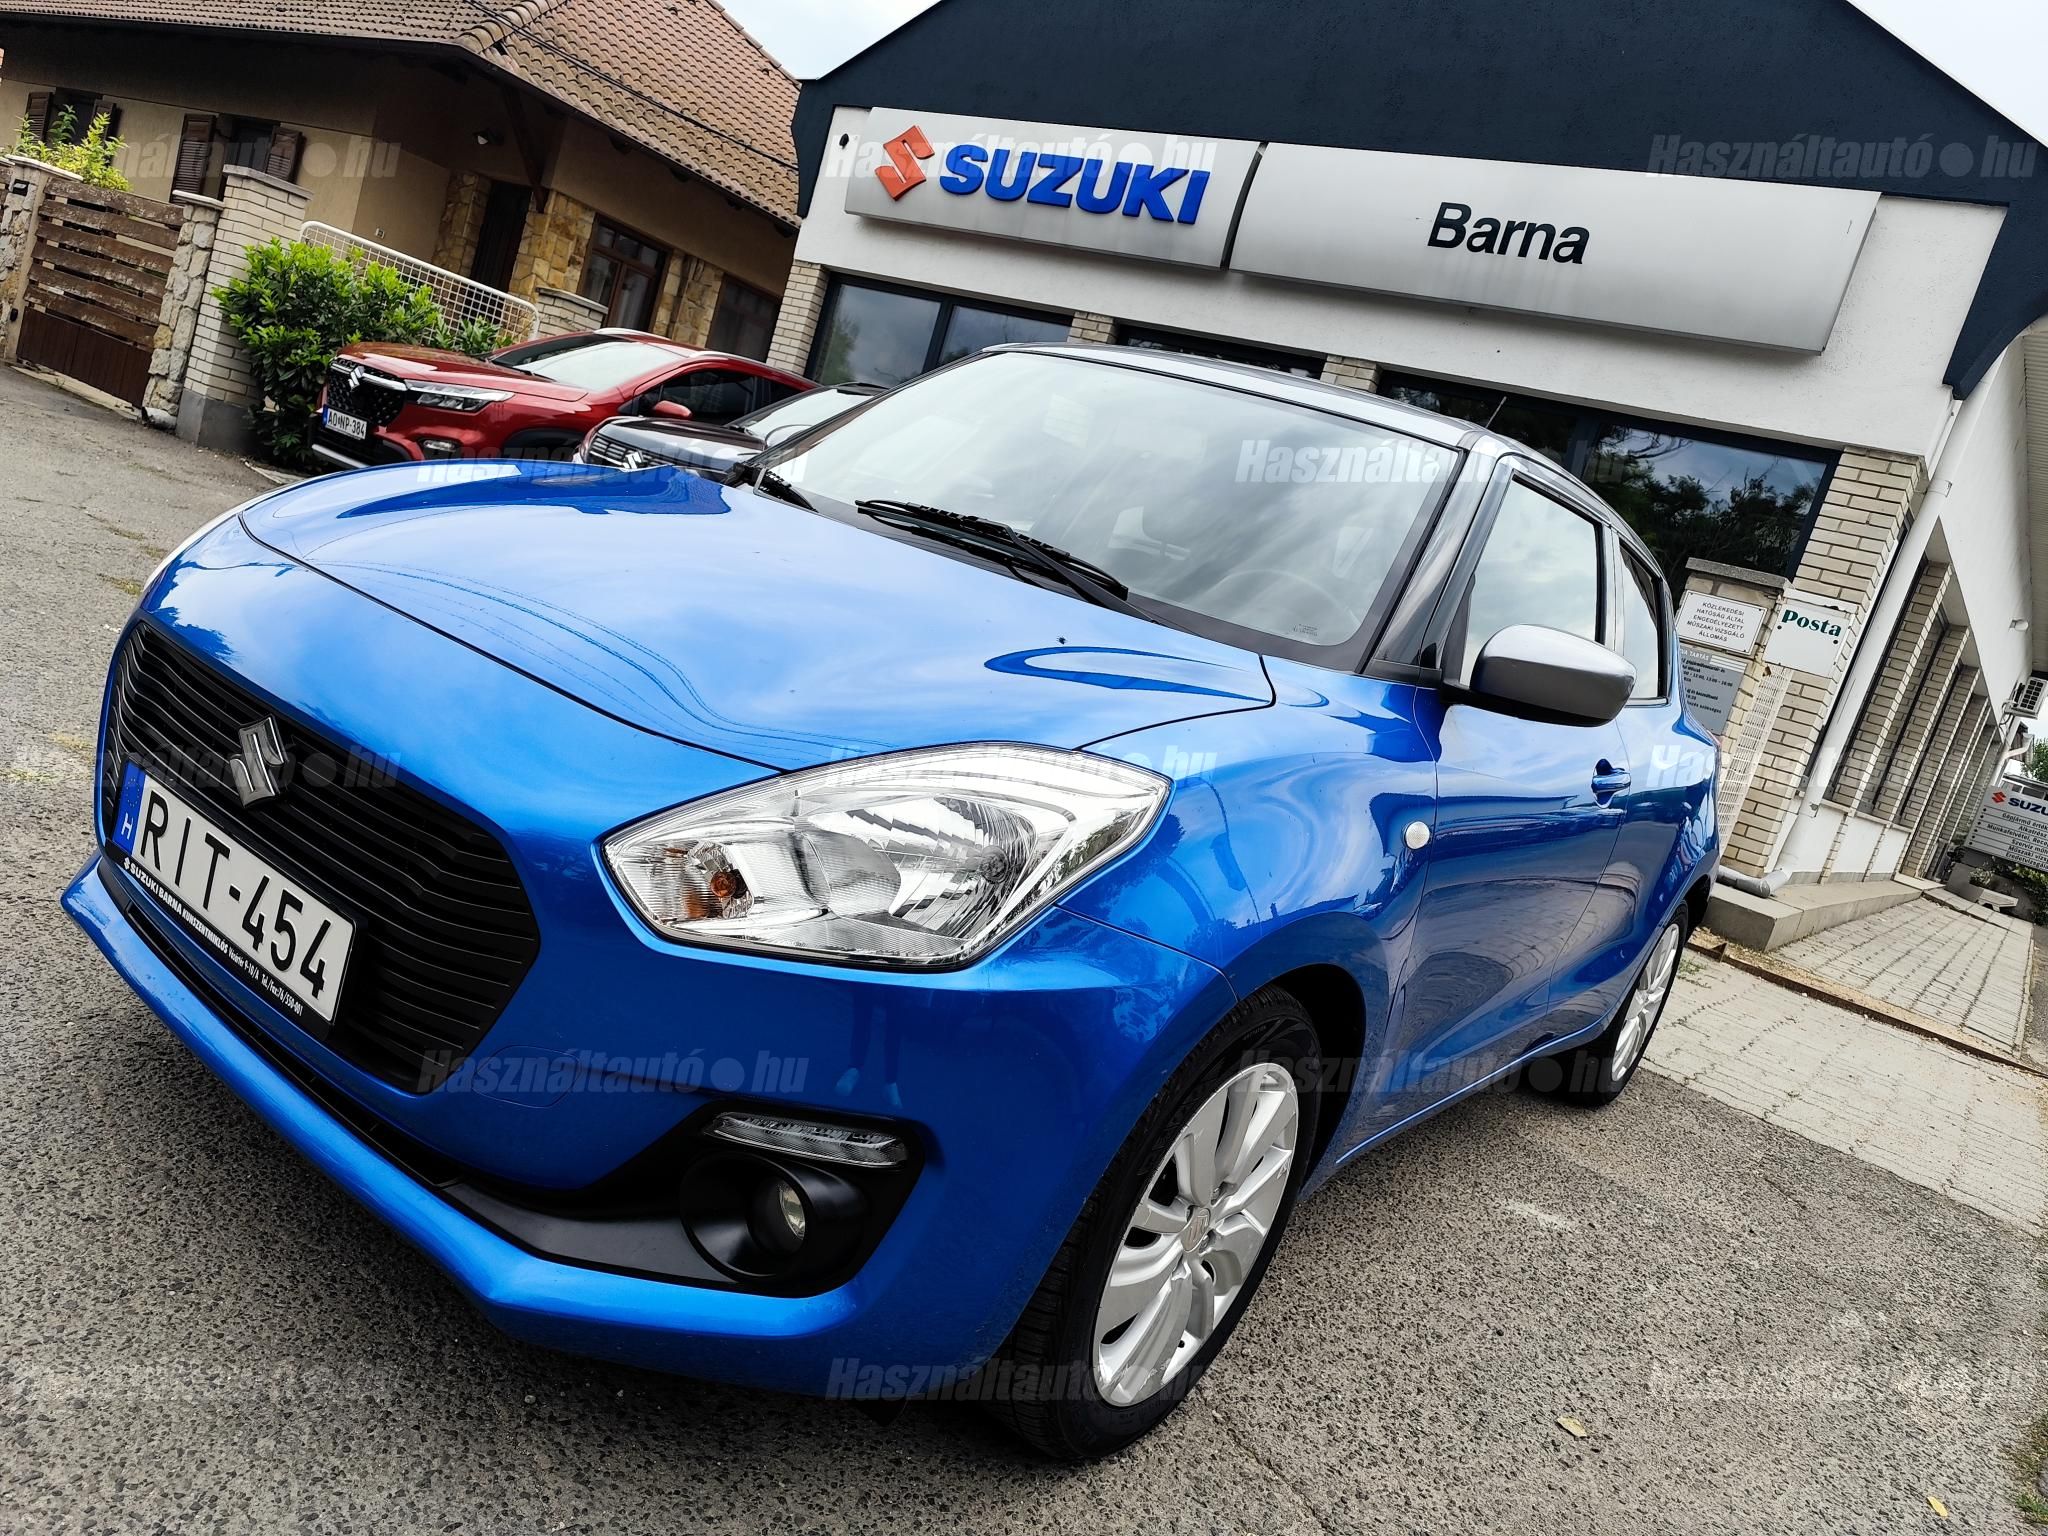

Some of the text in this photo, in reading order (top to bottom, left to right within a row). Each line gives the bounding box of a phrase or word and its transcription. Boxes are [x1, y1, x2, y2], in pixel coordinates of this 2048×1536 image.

[939, 143, 1211, 224] SUZUKI
[1427, 202, 1590, 264] Barna
[1696, 608, 1744, 624] HATÓSÁG ÁLTAL
[1702, 602, 1744, 616] KÖZLEKEDÉSI
[1693, 614, 1743, 631] ENGEDÉLYEZETT
[1781, 609, 1842, 637] Posta
[1699, 630, 1728, 642] ÁLLOMÁS
[1715, 627, 1745, 639] VIZSGÁLÓ
[121, 812, 134, 840] H
[2002, 812, 2032, 826] Gépjármű
[2018, 825, 2047, 838] Alkatrész
[2011, 838, 2034, 850] Szerviz
[130, 862, 159, 895] SUZUKI
[158, 887, 182, 915] BARNA
[140, 790, 332, 1000] RIT-454
